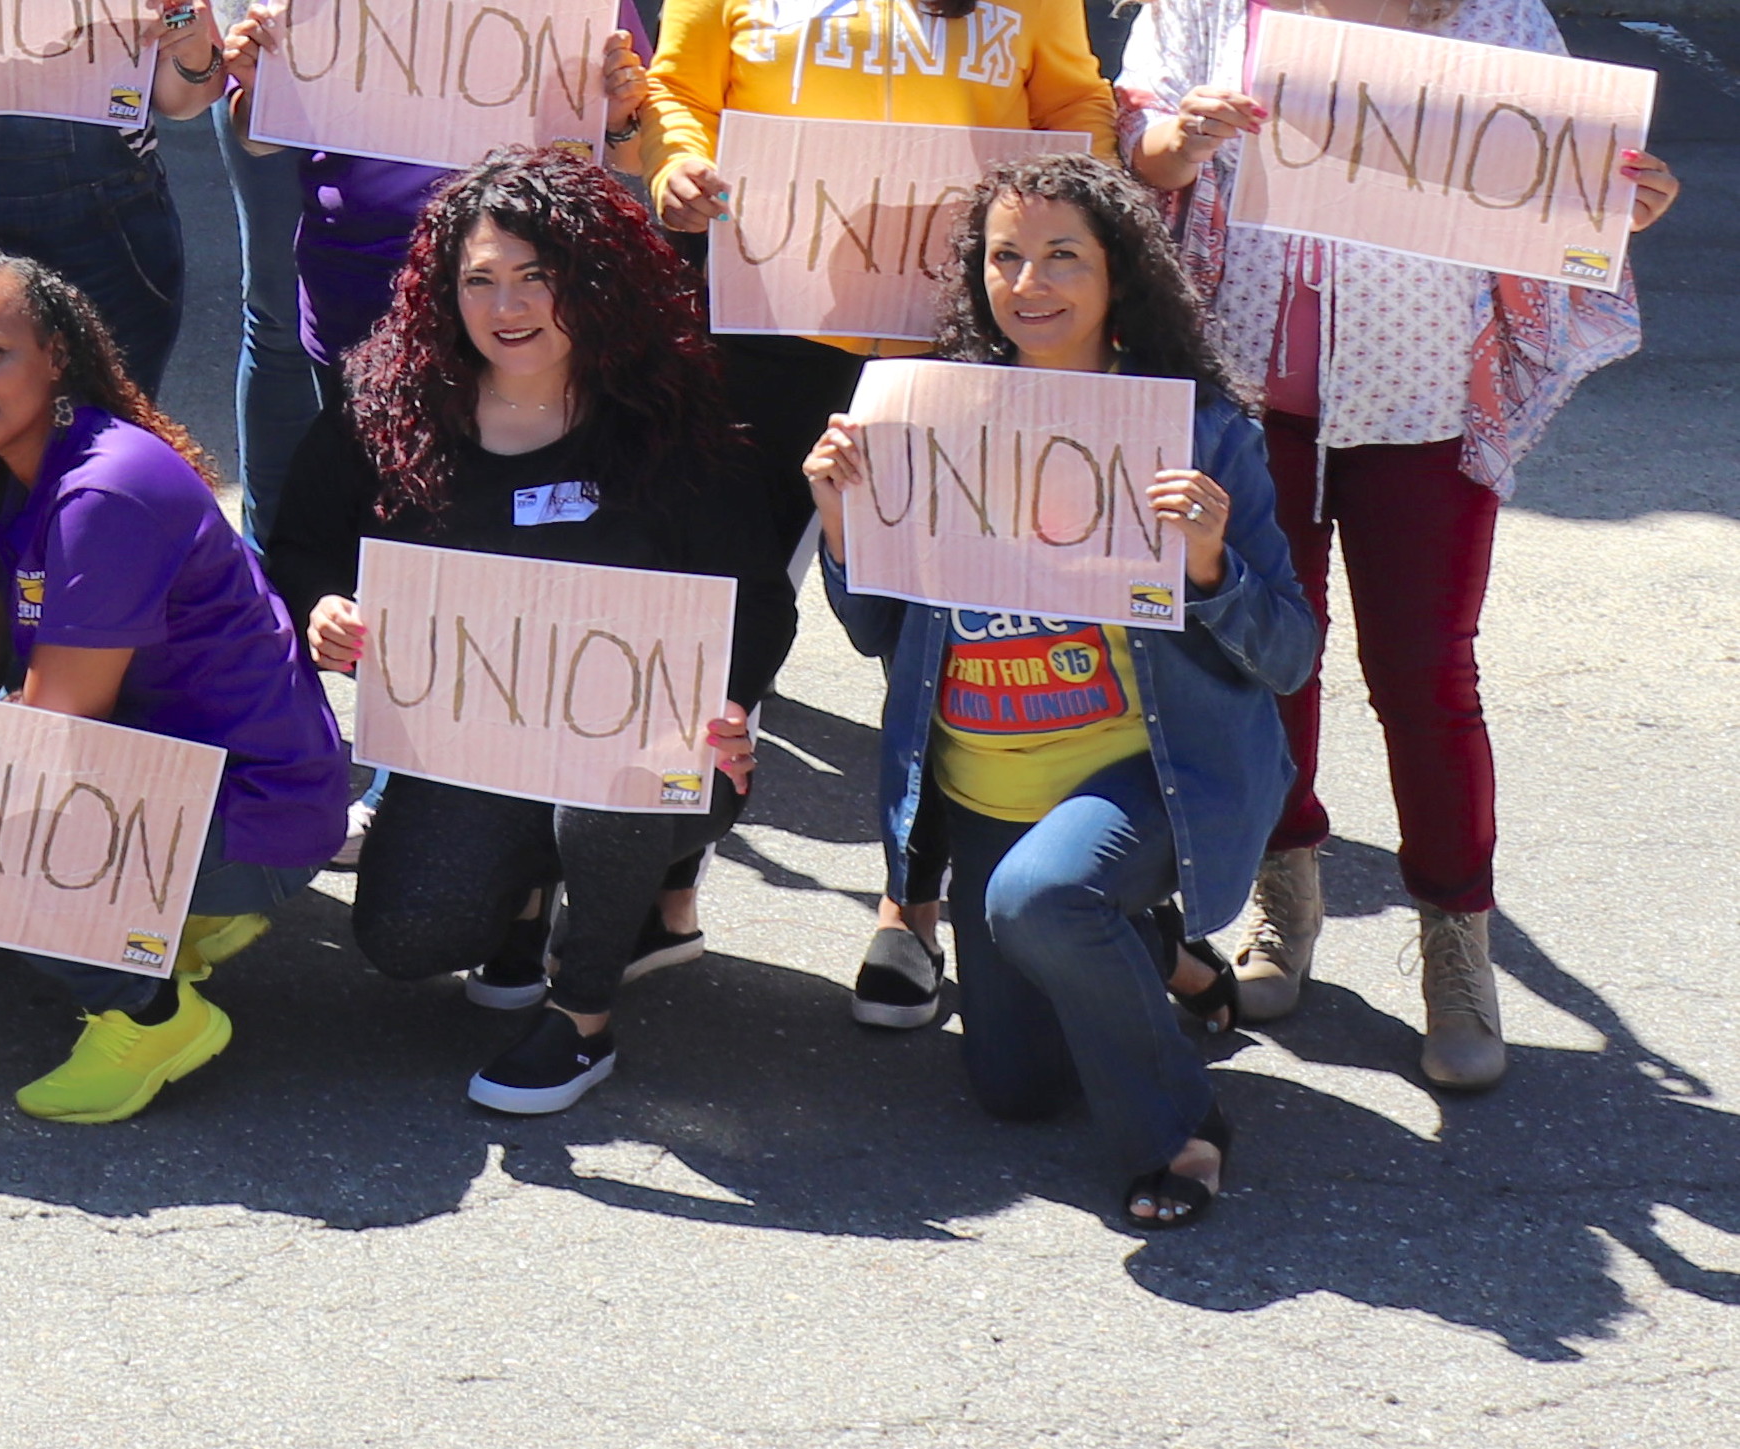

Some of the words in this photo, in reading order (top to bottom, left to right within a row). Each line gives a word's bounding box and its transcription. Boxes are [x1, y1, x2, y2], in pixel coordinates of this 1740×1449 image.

[109, 106, 139, 116] SEIU
[1272, 72, 1617, 233] UNION
[1562, 264, 1605, 277] SEIU
[862, 425, 1162, 563] UNION
[1132, 604, 1171, 615] SEIU
[380, 608, 703, 750] UNION
[999, 657, 1049, 687] FOR
[1051, 647, 1092, 676] $15
[949, 688, 992, 721] AND
[1001, 694, 1017, 722] A
[1023, 685, 1109, 722] UNION
[663, 791, 699, 800] SEIU
[123, 950, 162, 962] SEIU
